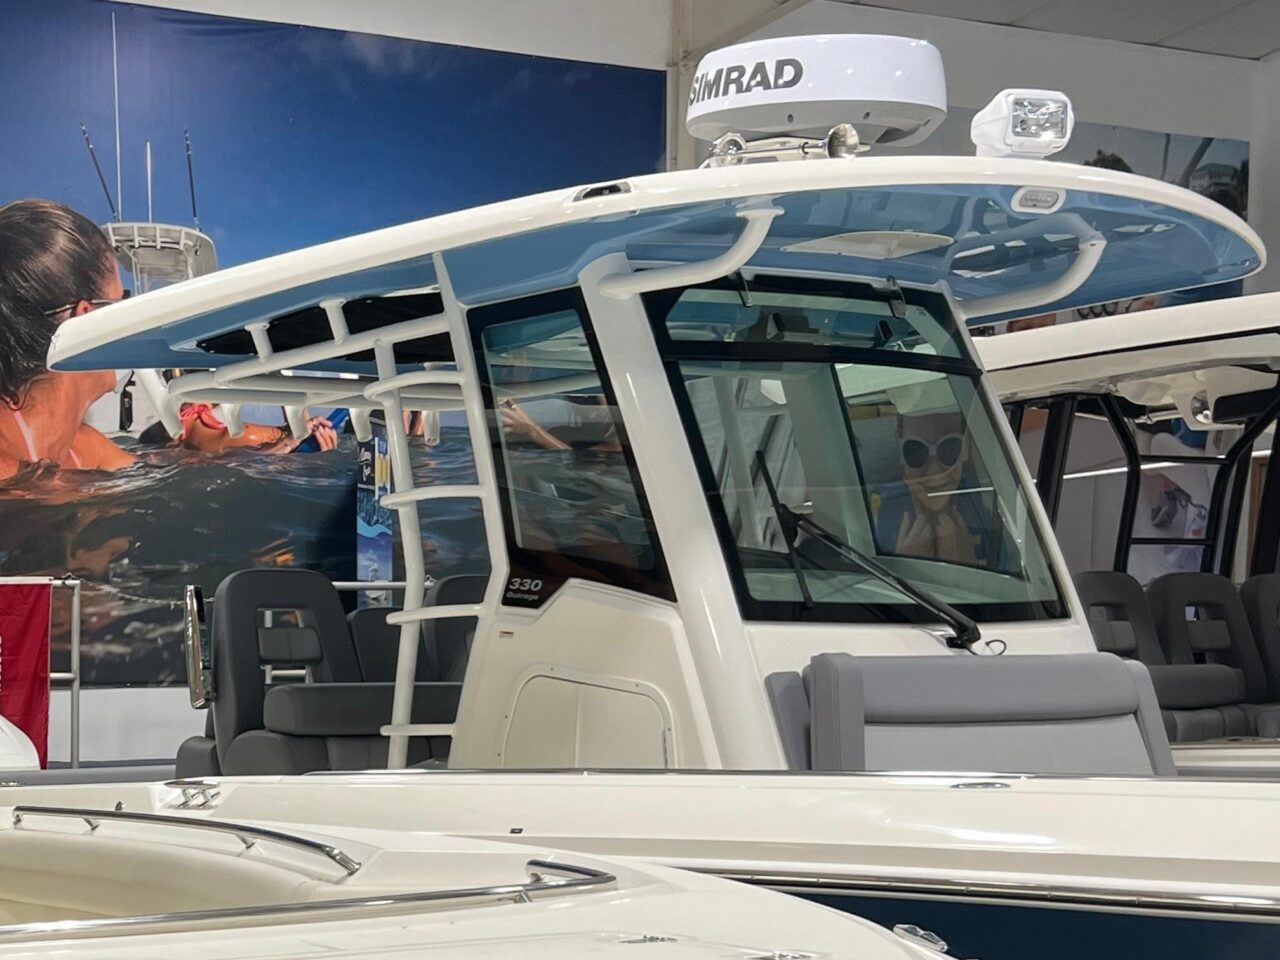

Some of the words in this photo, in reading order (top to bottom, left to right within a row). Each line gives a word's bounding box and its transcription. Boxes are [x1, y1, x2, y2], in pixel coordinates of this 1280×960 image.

[689, 58, 804, 106] SIMRAD
[508, 577, 543, 592] 330
[506, 591, 540, 602] Outrage
